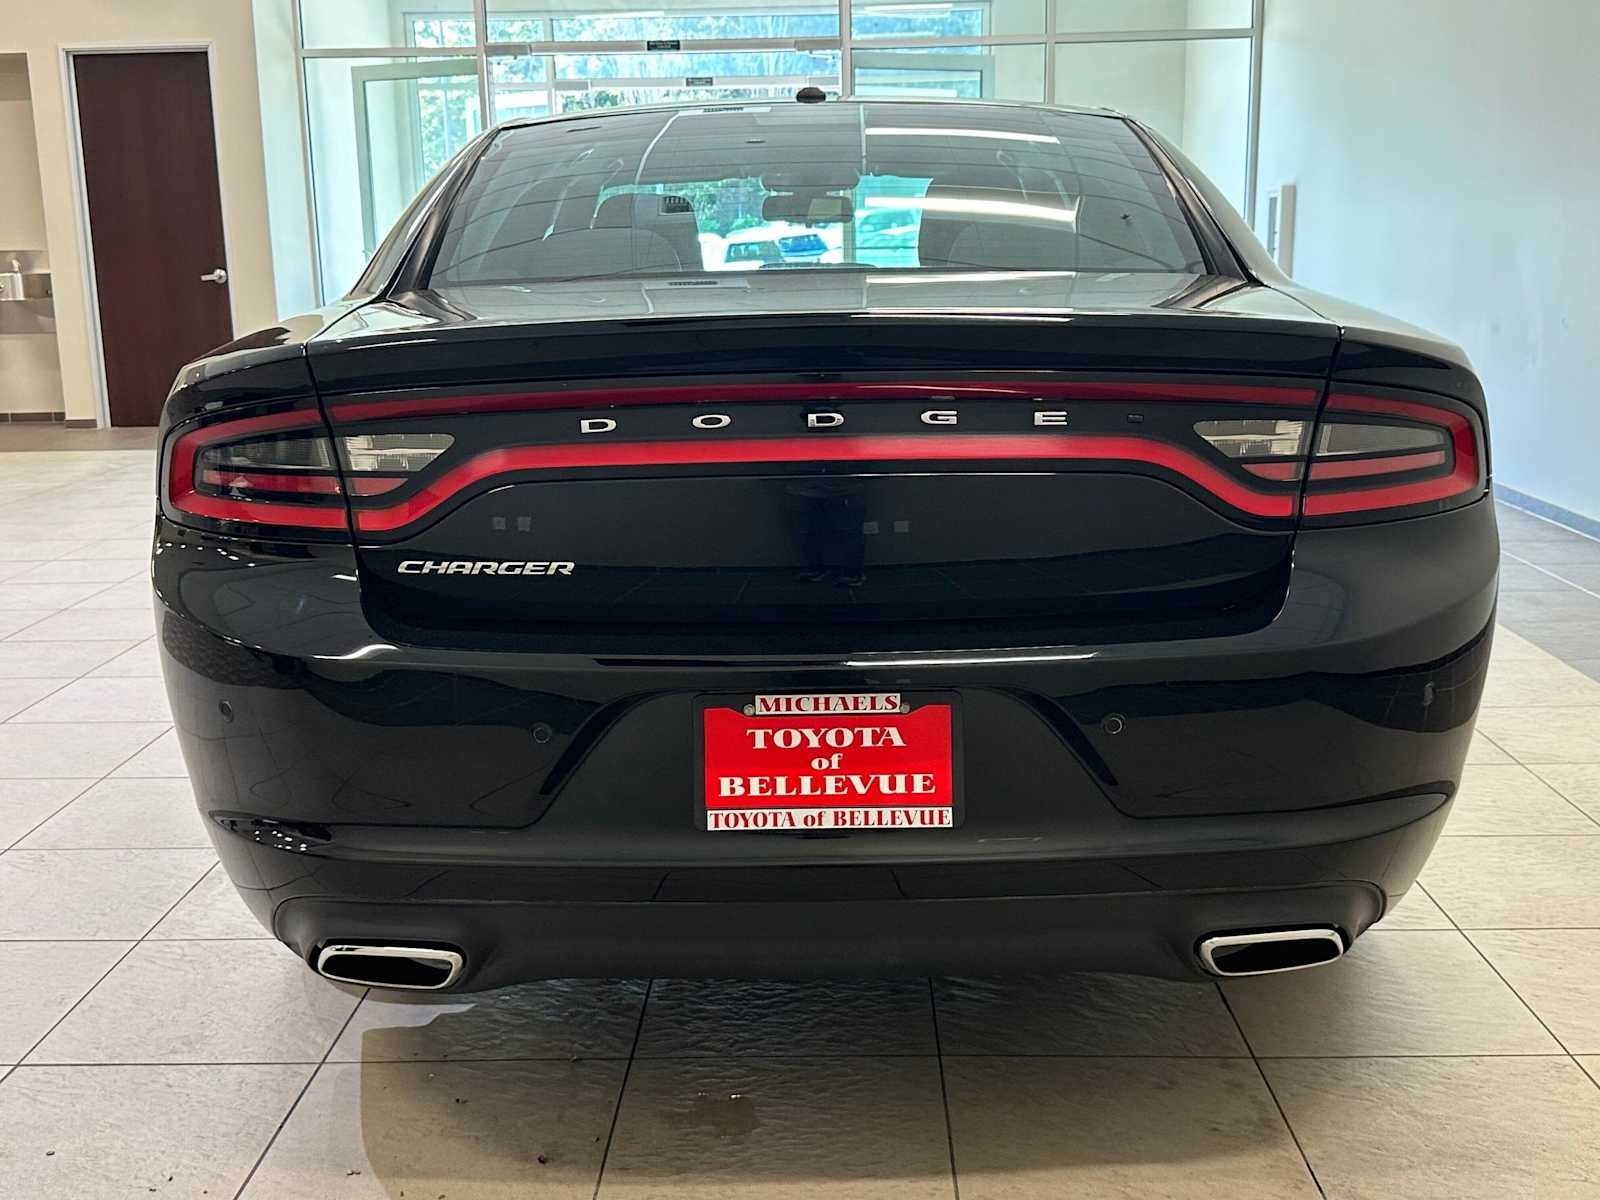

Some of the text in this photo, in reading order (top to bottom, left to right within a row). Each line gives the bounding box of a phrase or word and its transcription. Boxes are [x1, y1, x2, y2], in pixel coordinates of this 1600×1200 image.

[580, 410, 1067, 433] DODGE
[398, 560, 575, 575] CHARGER
[759, 695, 898, 712] MICHAELS
[747, 727, 906, 749] TOYOTA
[811, 753, 843, 770] of
[718, 774, 936, 797] BELLEVUE
[709, 809, 950, 829] TOYOTA of BELLEVUE
